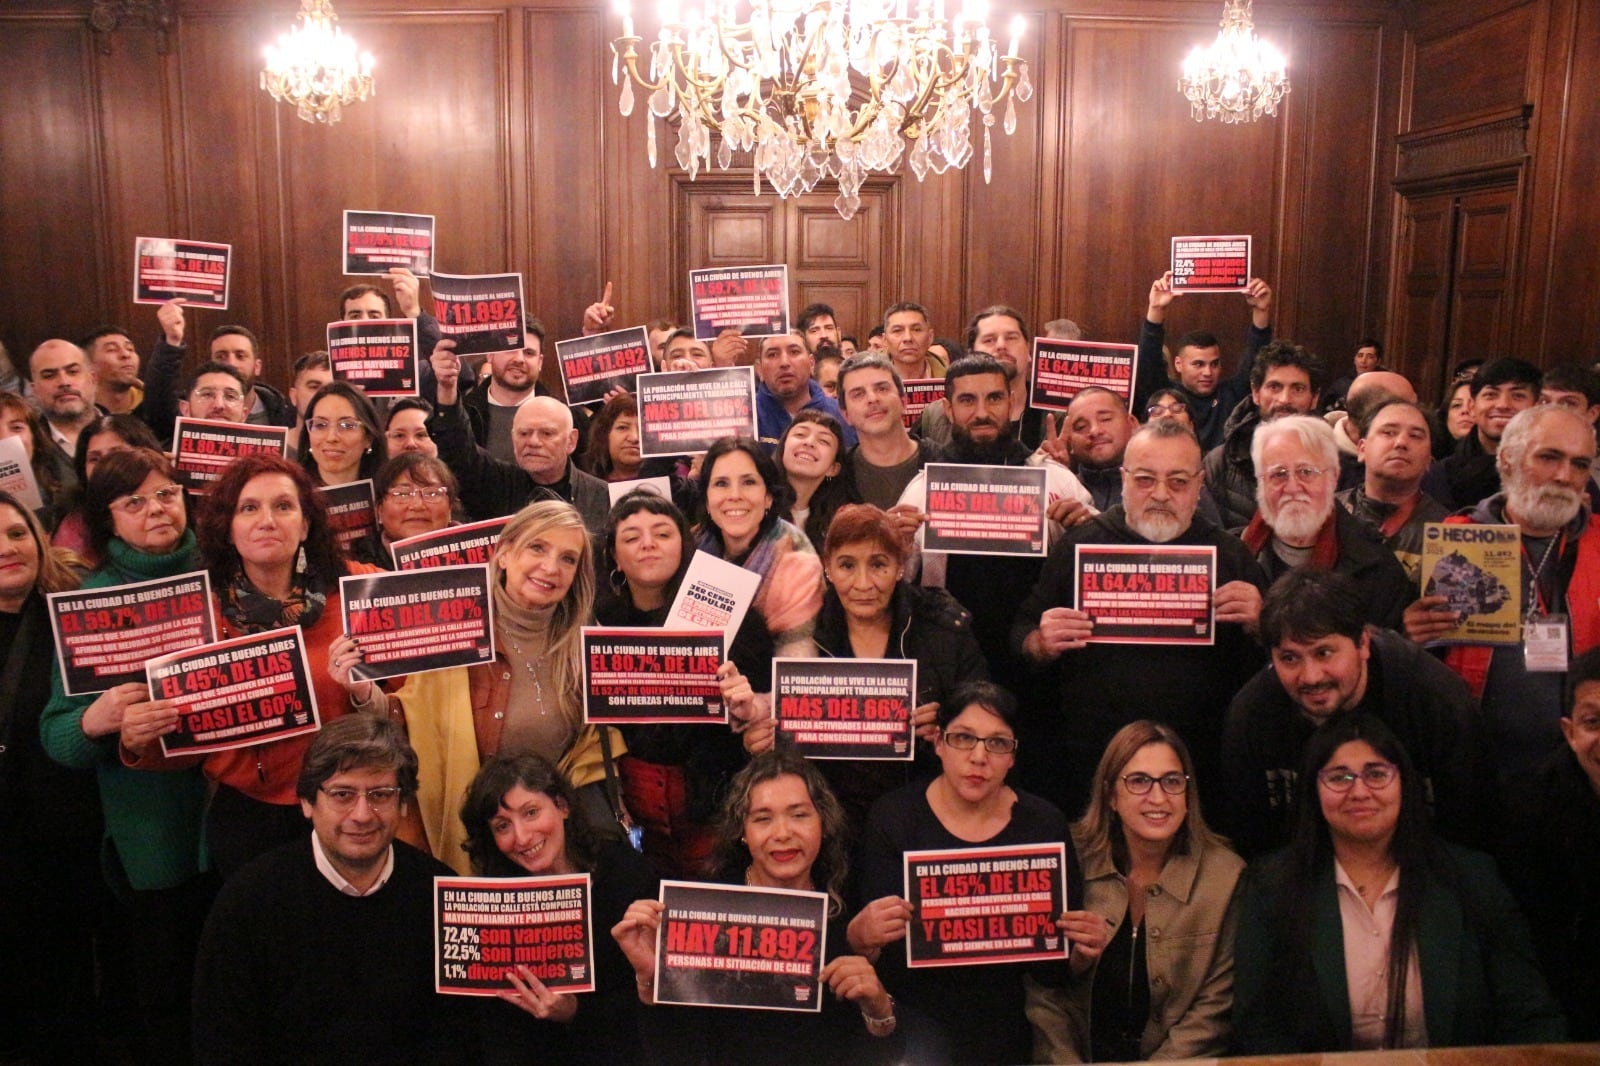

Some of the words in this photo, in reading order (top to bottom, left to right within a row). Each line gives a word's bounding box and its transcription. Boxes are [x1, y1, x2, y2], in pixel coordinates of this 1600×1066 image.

[452, 300, 516, 323] 11.892
[392, 346, 409, 357] 162
[565, 357, 592, 377] HAY
[597, 347, 645, 370] 11.892
[929, 490, 966, 511] MÁS
[971, 494, 999, 512] DEL
[1003, 495, 1039, 514] 40%
[1442, 528, 1495, 543] HECHO
[410, 552, 420, 560] LA
[420, 545, 449, 558] CIUDAD
[450, 543, 460, 551] DE
[460, 537, 489, 549] BUENOS
[1084, 564, 1094, 572] EN
[1095, 564, 1105, 572] LA
[1106, 564, 1137, 573] CIUDAD
[1139, 564, 1148, 573] DE
[1150, 564, 1182, 573] BUENOS
[1184, 565, 1207, 574] AIRES
[1083, 574, 1099, 591] EL
[1156, 575, 1175, 591] DE
[1180, 575, 1208, 592] LAS
[58, 602, 70, 612] EN
[72, 601, 84, 610] LA
[86, 597, 122, 609] CIUDAD
[124, 594, 137, 604] DE
[138, 588, 174, 602] BUENOS
[176, 582, 201, 594] AIRES
[349, 600, 360, 610] EN
[362, 599, 372, 609] LA
[374, 595, 407, 607] CIUDAD
[408, 593, 419, 603] DE
[421, 590, 454, 601] BUENOS
[456, 587, 481, 596] AIRES
[687, 590, 733, 612] POPULAR
[708, 591, 735, 605] CENSO
[60, 614, 81, 632] EL
[144, 601, 167, 620] DE
[172, 593, 204, 615] LAS
[350, 606, 394, 633] MÁS
[401, 603, 434, 627] DEL
[438, 597, 481, 620] 40%
[591, 645, 600, 654] EN
[603, 646, 612, 654] LA
[614, 646, 645, 655] CIUDAD
[647, 647, 658, 655] DE
[660, 647, 692, 656] BUENOS
[694, 647, 718, 656] AIRES
[591, 654, 608, 672] EL
[664, 656, 684, 672] DE
[690, 656, 718, 673] LAS
[162, 678, 183, 698] EL
[185, 666, 228, 692] 45%
[230, 661, 256, 682] DE
[258, 653, 292, 676] LAS
[781, 676, 789, 684] LA
[791, 675, 832, 685] POBLACIÓN
[834, 677, 848, 685] QUE
[849, 677, 865, 686] VIVE
[867, 678, 876, 686] EN
[877, 678, 886, 686] LA
[887, 678, 908, 686] CALLE
[609, 696, 626, 705] SON
[627, 697, 662, 705] FUERZAS
[664, 695, 703, 705] PÚBLICAS
[781, 686, 790, 694] ES
[791, 686, 853, 695] PRINCIPALMENTE
[188, 708, 233, 732] CASI
[236, 703, 258, 722] EL
[260, 692, 302, 718] 60%
[781, 693, 822, 719] MÁS
[827, 698, 859, 719] DEL
[865, 699, 907, 720] 66%
[916, 866, 928, 876] EN
[930, 865, 941, 875] LA
[942, 862, 977, 875] CIUDAD
[979, 861, 991, 872] DE
[993, 859, 1029, 872] BUENOS
[1030, 858, 1057, 869] AIRES
[920, 877, 940, 898] EL
[944, 874, 985, 896] 45%
[990, 873, 1013, 893] DE
[1018, 870, 1051, 892] LAS
[444, 891, 454, 902] EN
[456, 891, 466, 902] LA
[468, 892, 500, 903] CIUDAD
[504, 893, 516, 903] DE
[517, 891, 554, 902] BUENOS
[556, 888, 582, 900] AIRES
[445, 902, 452, 910] LA
[453, 903, 489, 912] POBLACIÓN
[501, 904, 520, 912] CALLE
[541, 900, 581, 910] COMPUESTA
[526, 914, 543, 923] POR
[545, 910, 581, 921] VARONES
[668, 909, 678, 918] EN
[679, 910, 688, 919] LA
[689, 911, 716, 921] CIUDAD
[718, 912, 727, 922] DE
[728, 913, 756, 923] BUENOS
[758, 915, 779, 925] AIRES
[780, 917, 788, 926] AL
[790, 917, 815, 928] MENOS
[443, 926, 479, 944] 72,4%
[480, 928, 510, 944] son
[514, 925, 583, 944] varones
[923, 921, 935, 942] Y
[939, 918, 984, 941] CASI
[989, 917, 1008, 937] EL
[1012, 914, 1055, 936] 60%
[667, 922, 720, 953] HAY
[726, 926, 815, 960] 11.892
[444, 944, 480, 961] 22,5%
[481, 947, 511, 962] son
[515, 943, 584, 962] mujeres
[668, 956, 712, 967] PERSONAS
[714, 958, 725, 967] EN
[727, 958, 772, 971] SITUACIÓN
[774, 961, 784, 972] DE
[786, 962, 811, 973] CALLE
